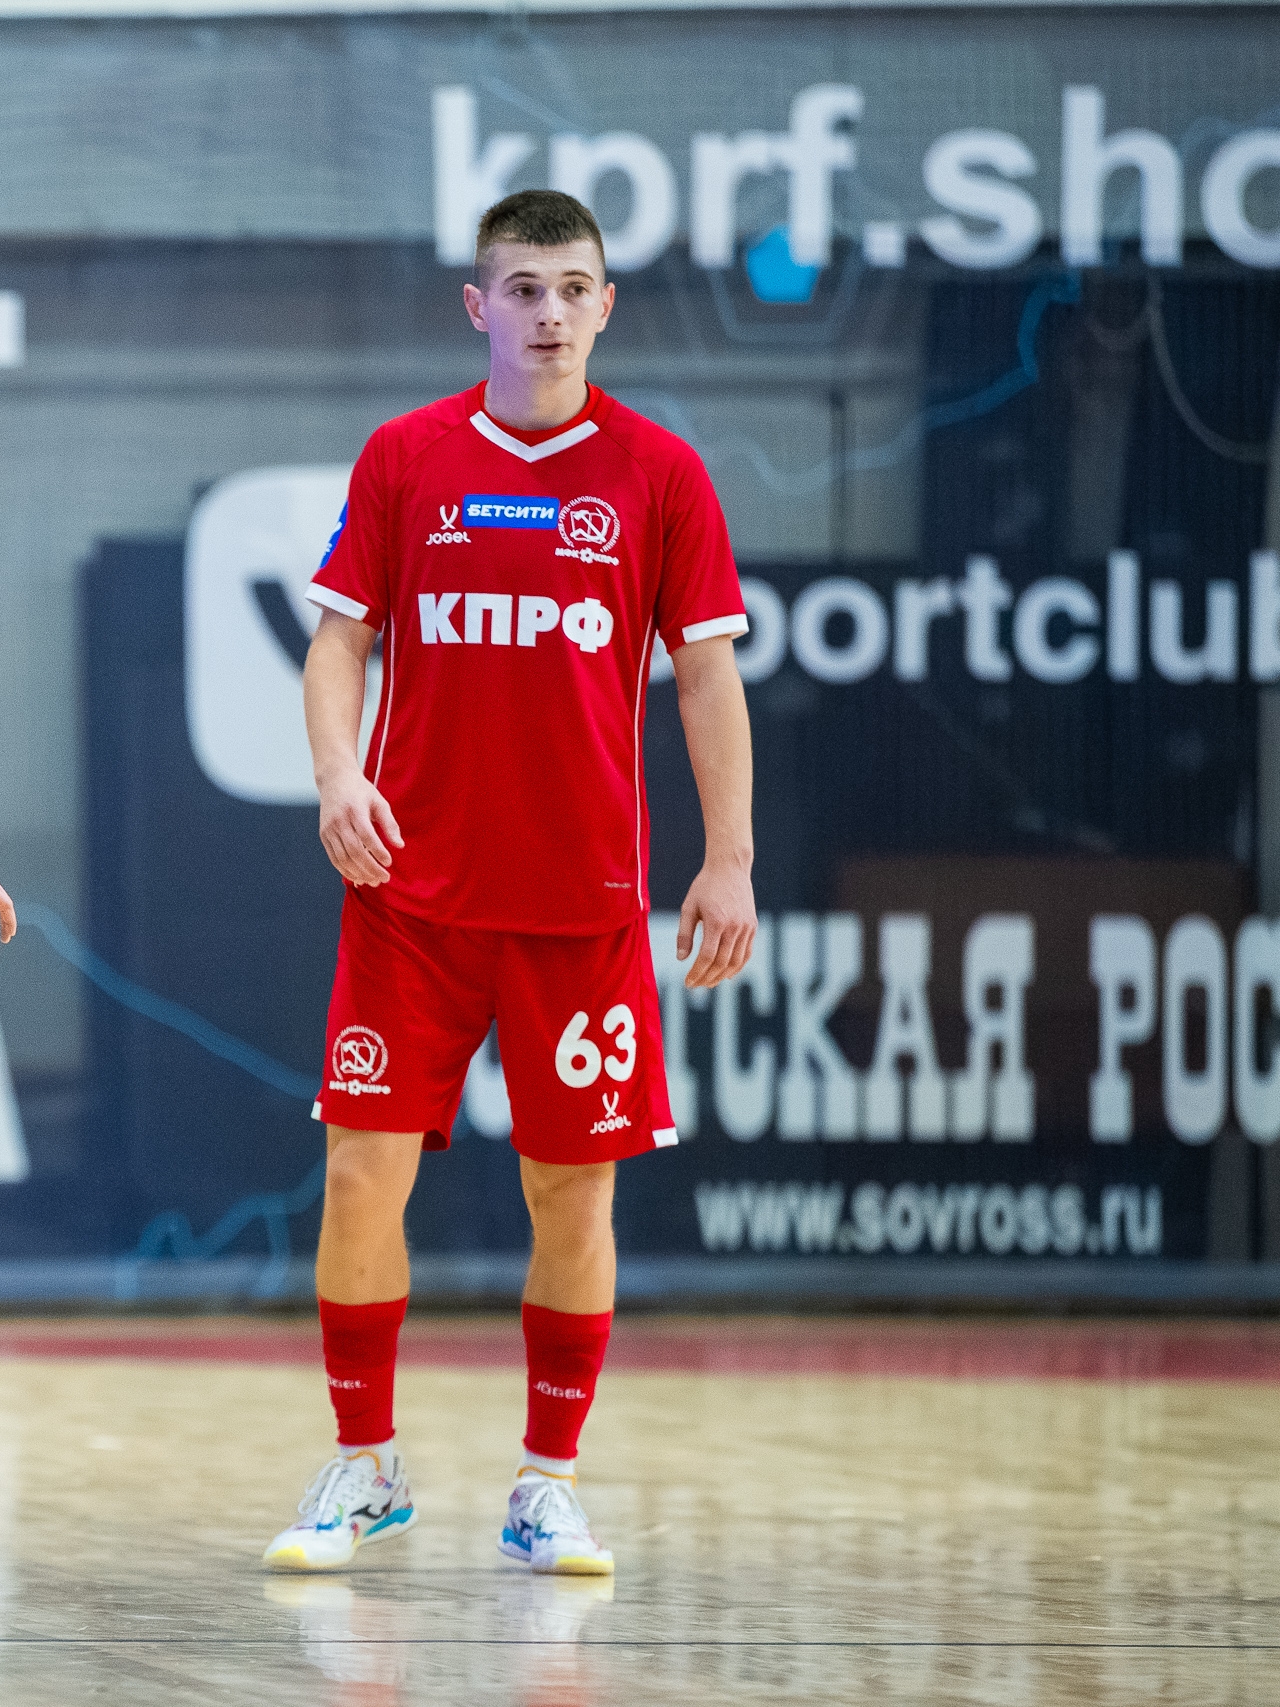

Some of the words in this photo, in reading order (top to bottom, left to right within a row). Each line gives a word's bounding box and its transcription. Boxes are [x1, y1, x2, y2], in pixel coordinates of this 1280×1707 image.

[466, 503, 555, 520] БЕТСИТИ
[417, 592, 615, 654] КПРФ
[555, 1003, 637, 1089] 63
[695, 1181, 1165, 1257] www.sovross.ru
